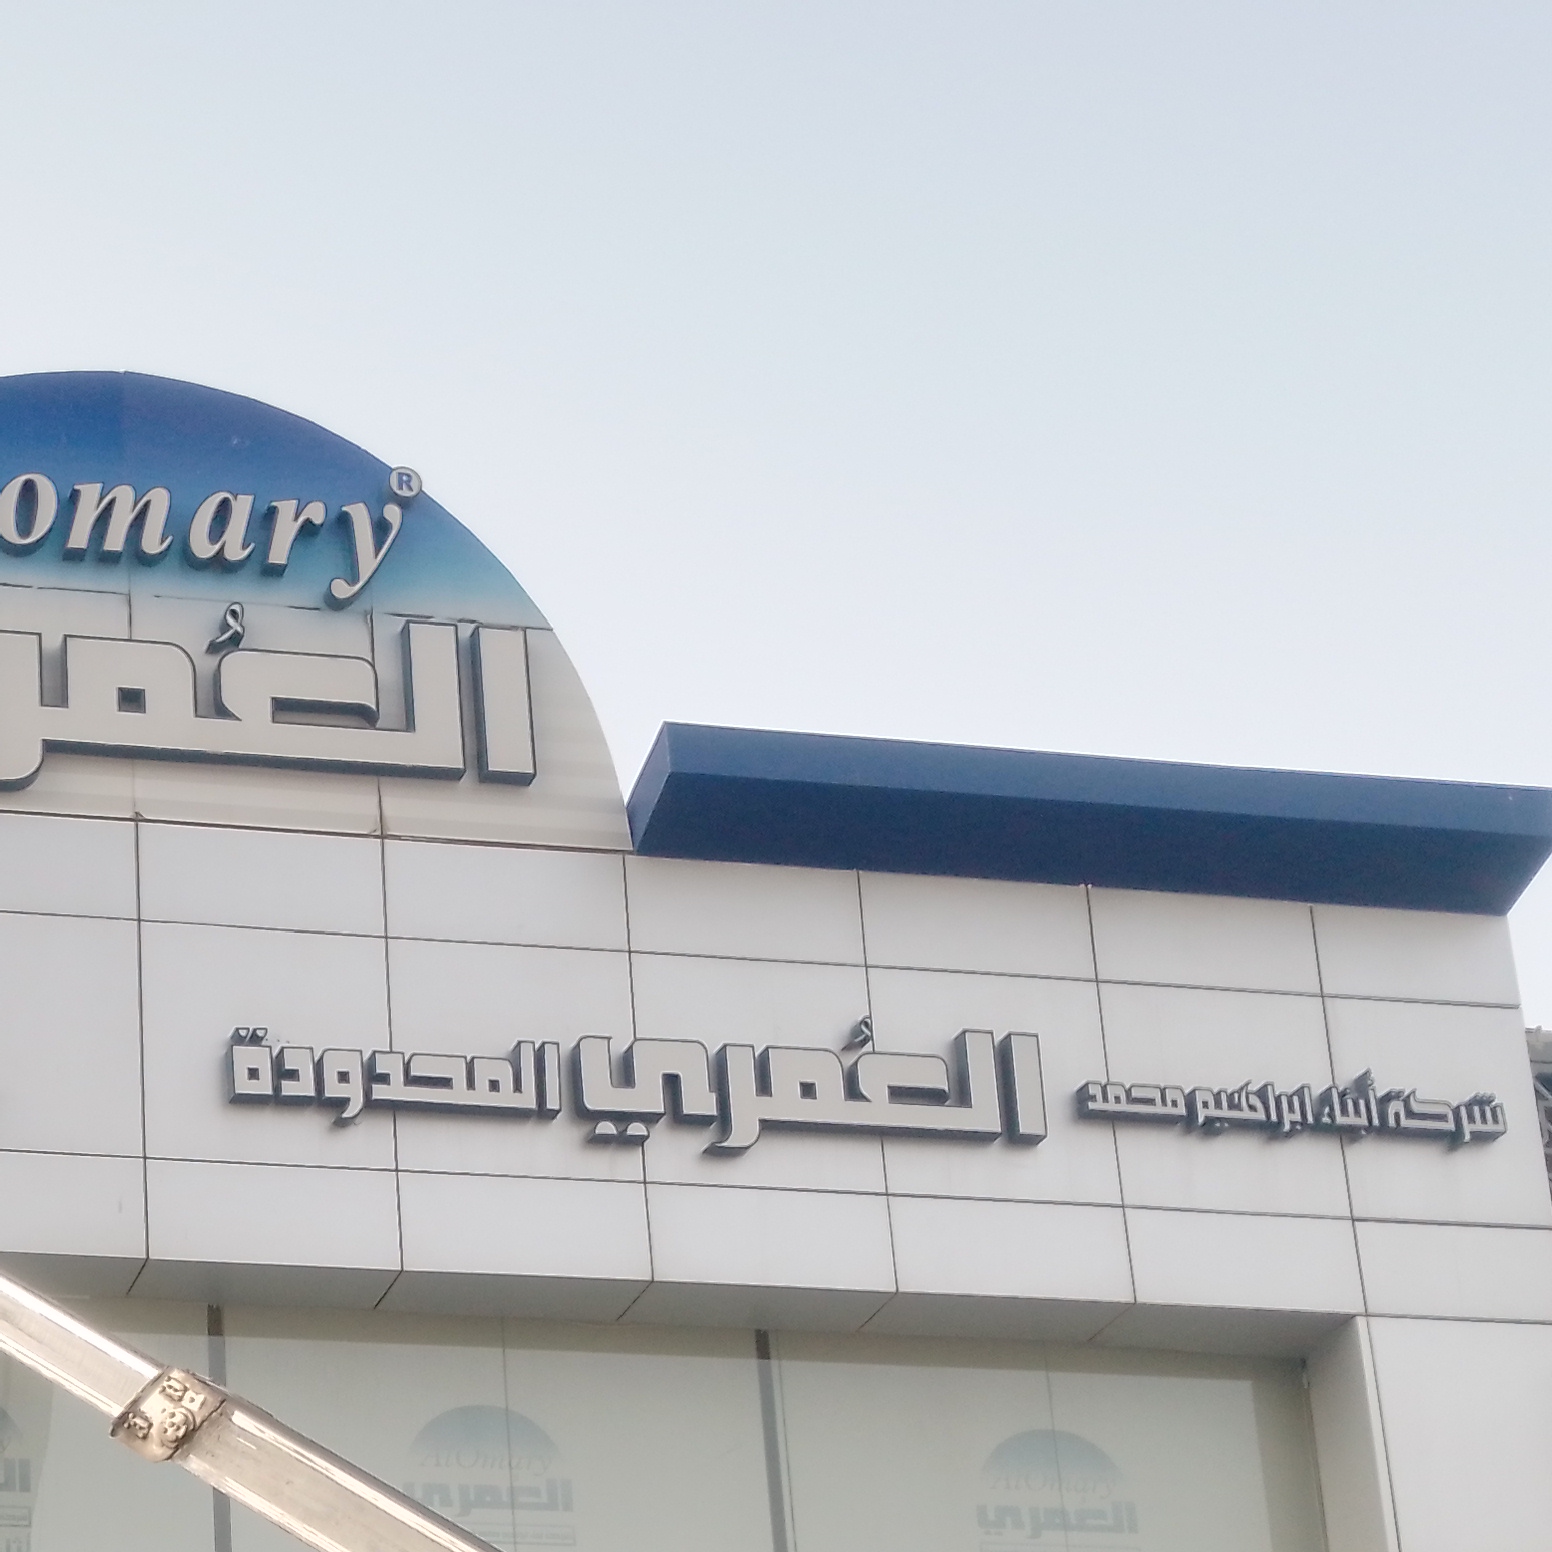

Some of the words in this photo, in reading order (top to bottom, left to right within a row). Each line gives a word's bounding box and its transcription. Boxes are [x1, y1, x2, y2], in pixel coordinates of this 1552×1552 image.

[227, 1025, 563, 1126] المحدودة
[1075, 1079, 1188, 1124] محمد
[1381, 1087, 1508, 1144] شركة
